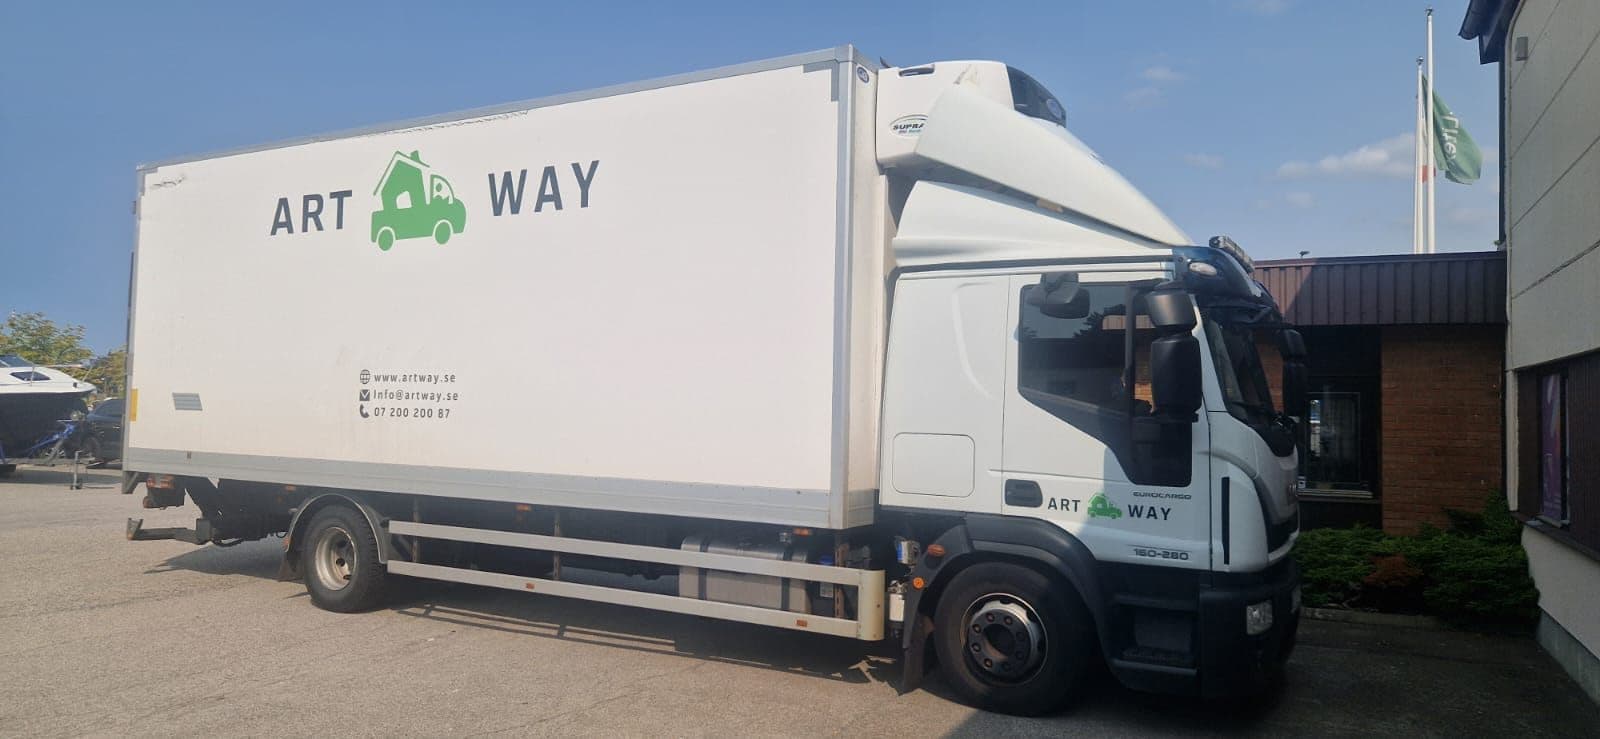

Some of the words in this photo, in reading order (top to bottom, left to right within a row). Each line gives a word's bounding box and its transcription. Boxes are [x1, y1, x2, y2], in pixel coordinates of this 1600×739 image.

[270, 189, 353, 236] ART
[487, 160, 600, 216] WAY
[374, 374, 456, 384] www.artway.se
[373, 389, 459, 402] Info@artway.se
[374, 407, 386, 417] 07
[390, 407, 409, 417] 200
[413, 408, 433, 418] 200
[438, 408, 450, 418] 87
[1133, 491, 1192, 500] EUROCARGO
[1048, 497, 1081, 512] ART
[1128, 504, 1172, 521] WAY
